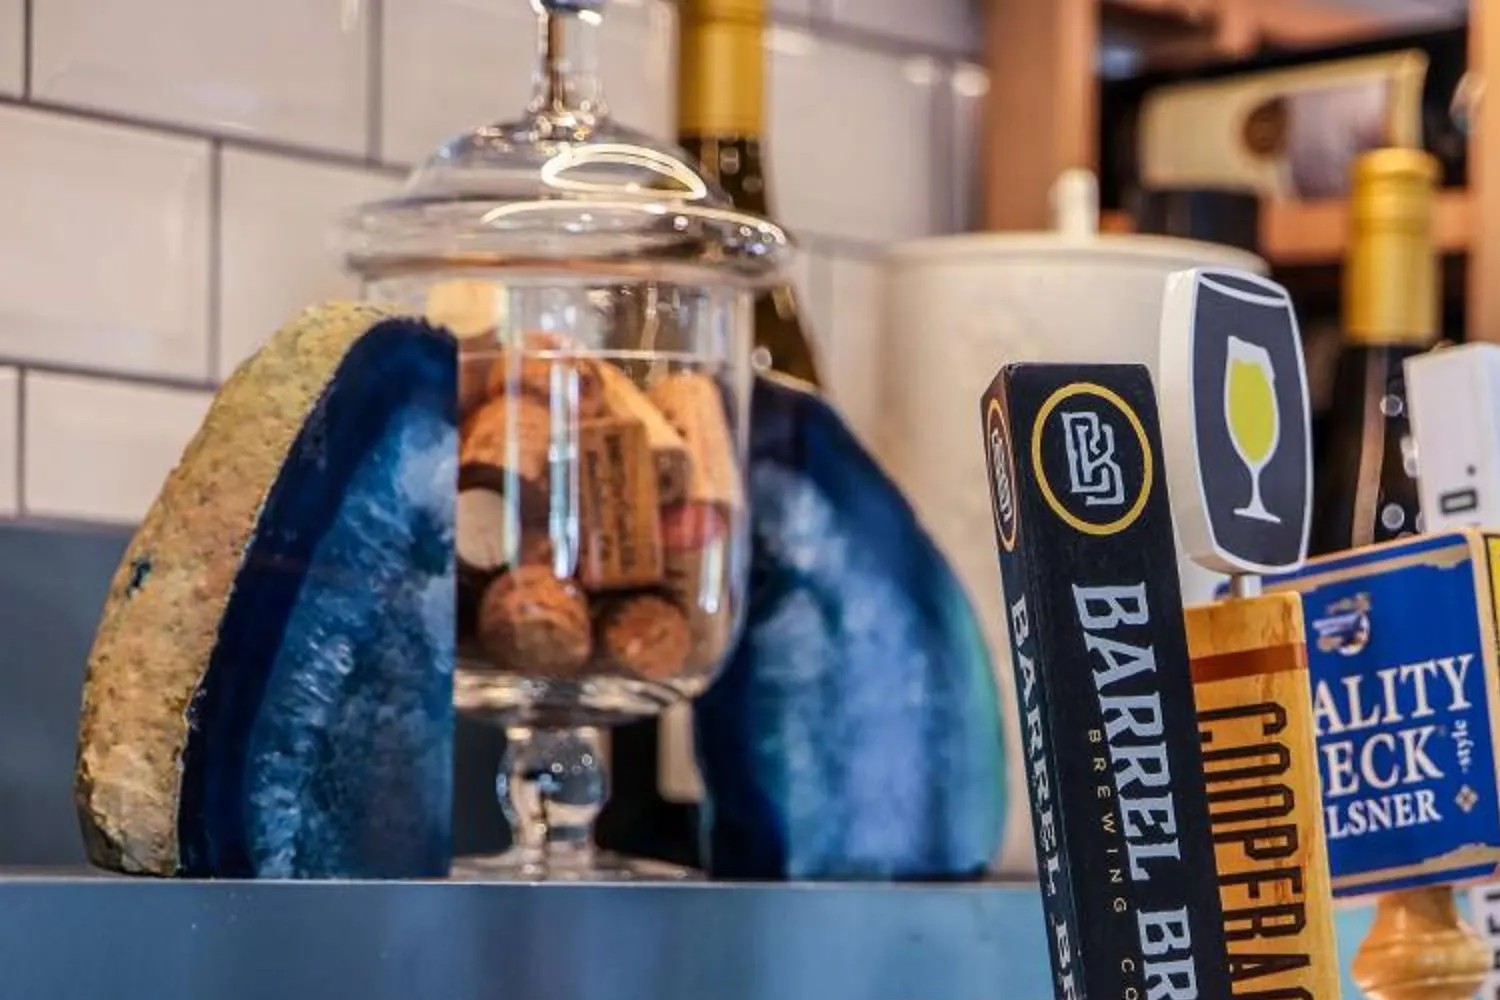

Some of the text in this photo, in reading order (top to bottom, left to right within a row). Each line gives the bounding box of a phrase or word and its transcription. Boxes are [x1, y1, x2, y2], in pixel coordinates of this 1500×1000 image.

[1440, 464, 1478, 517] O.
[1072, 581, 1181, 882] BARREL
[1313, 653, 1475, 738] ALITY
[1011, 594, 1061, 897] BARREL
[1320, 726, 1446, 800] ECK
[1088, 729, 1127, 914] BREWING
[1325, 788, 1442, 840] LSNER
